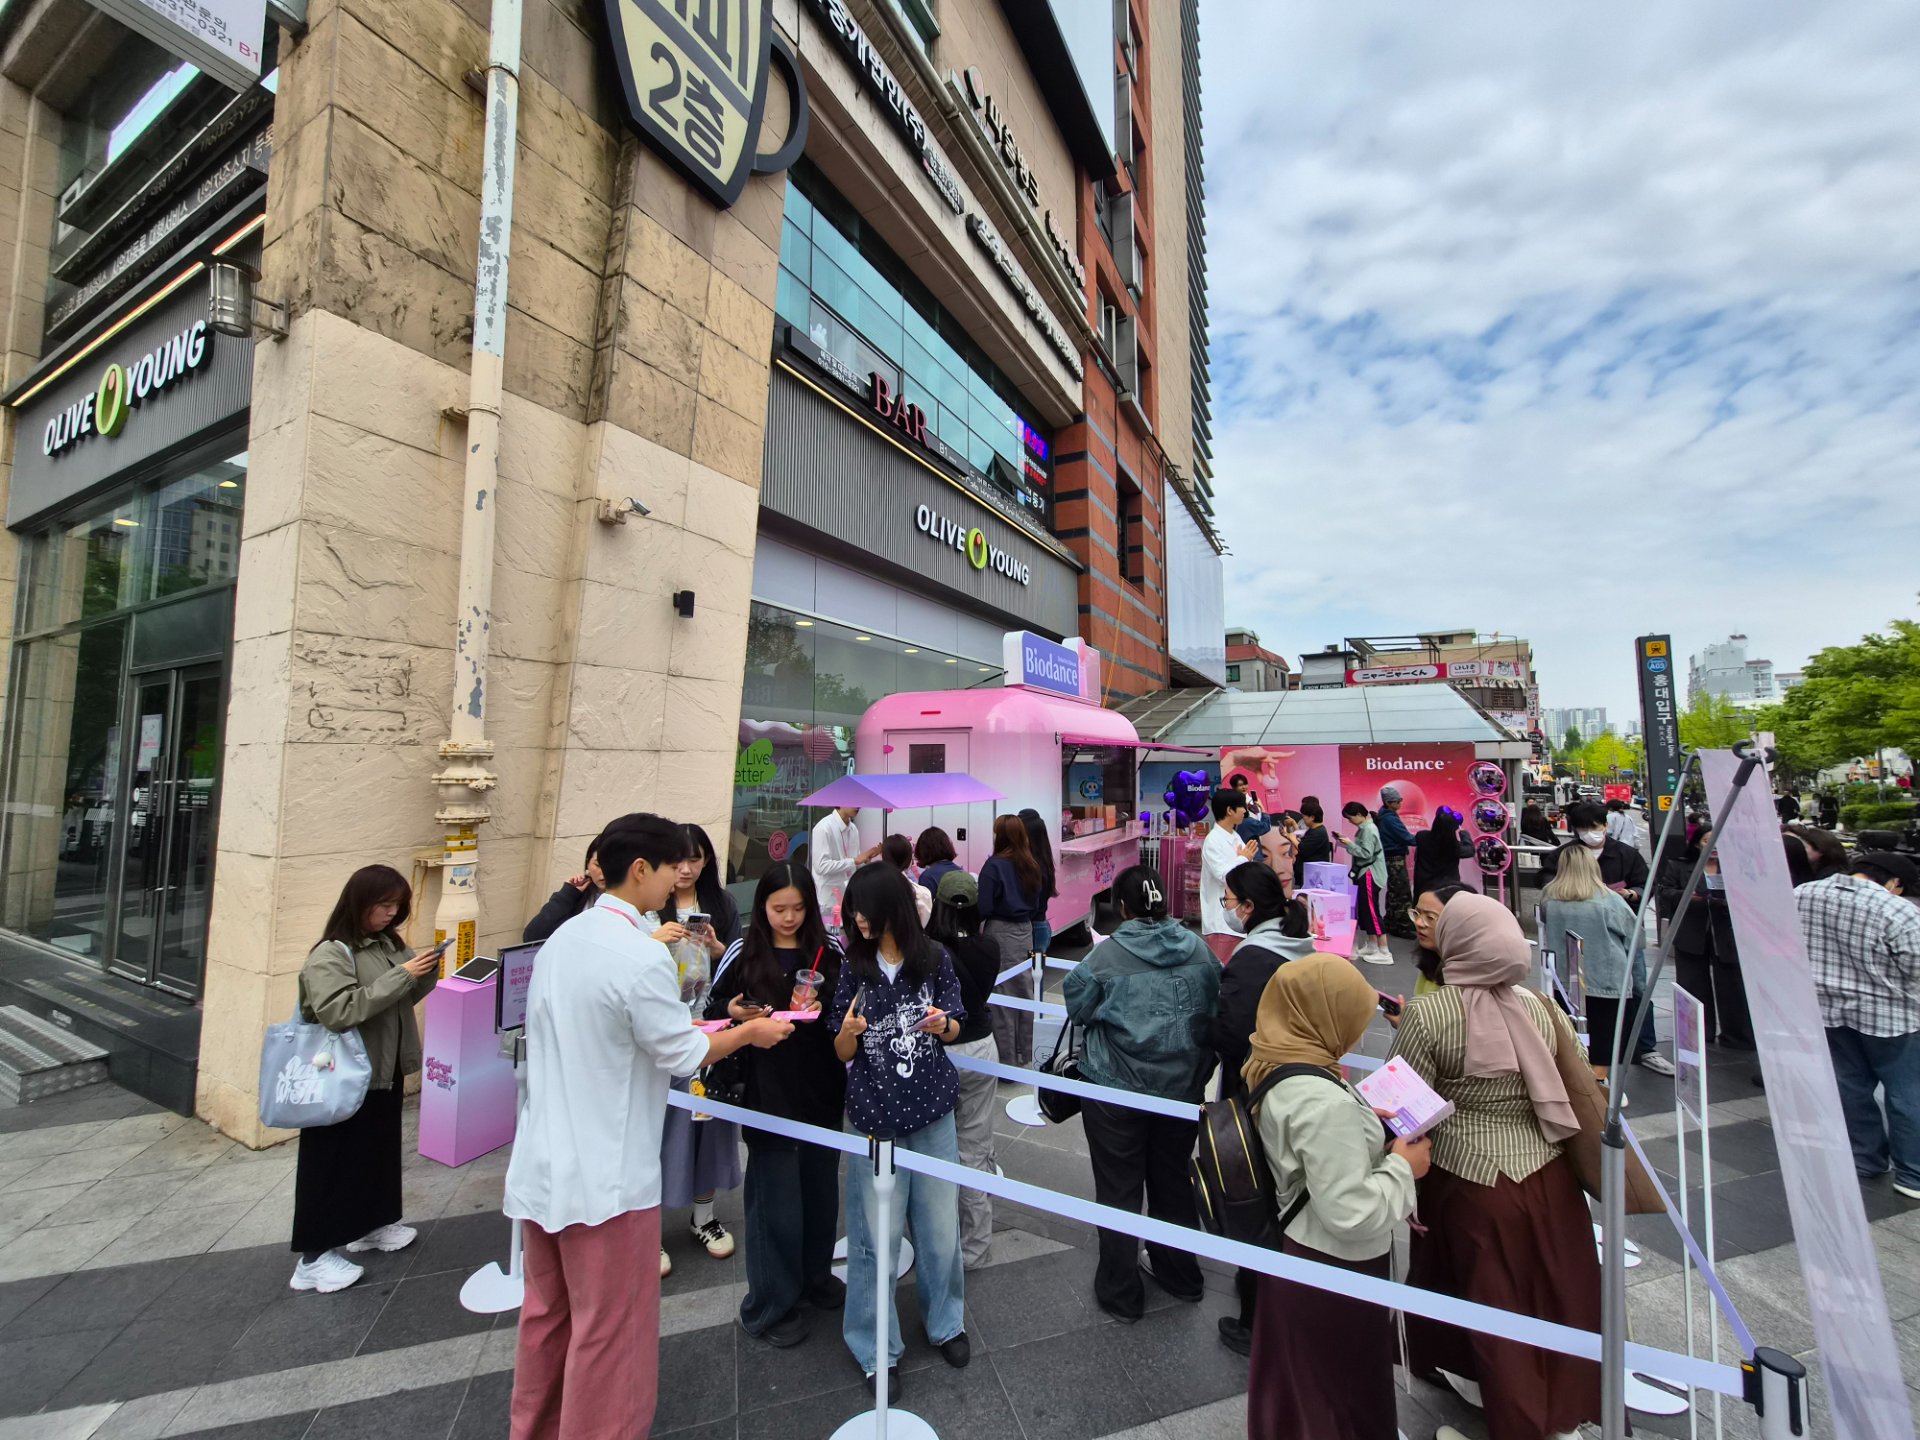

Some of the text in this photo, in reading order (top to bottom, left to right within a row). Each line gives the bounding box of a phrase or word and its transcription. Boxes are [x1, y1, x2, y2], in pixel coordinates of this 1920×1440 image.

[240, 41, 259, 62] B1
[649, 42, 725, 169] 2층
[43, 320, 207, 456] OLIVE YOUNG
[874, 372, 930, 449] BAR
[917, 504, 966, 552] OLIVE
[988, 544, 1030, 586] YOUNG
[1025, 646, 1078, 687] Biodance
[1653, 674, 1673, 725] 홍대입구
[746, 749, 770, 765] Live
[1366, 756, 1445, 770] Biodance
[1664, 797, 1673, 807] 3
